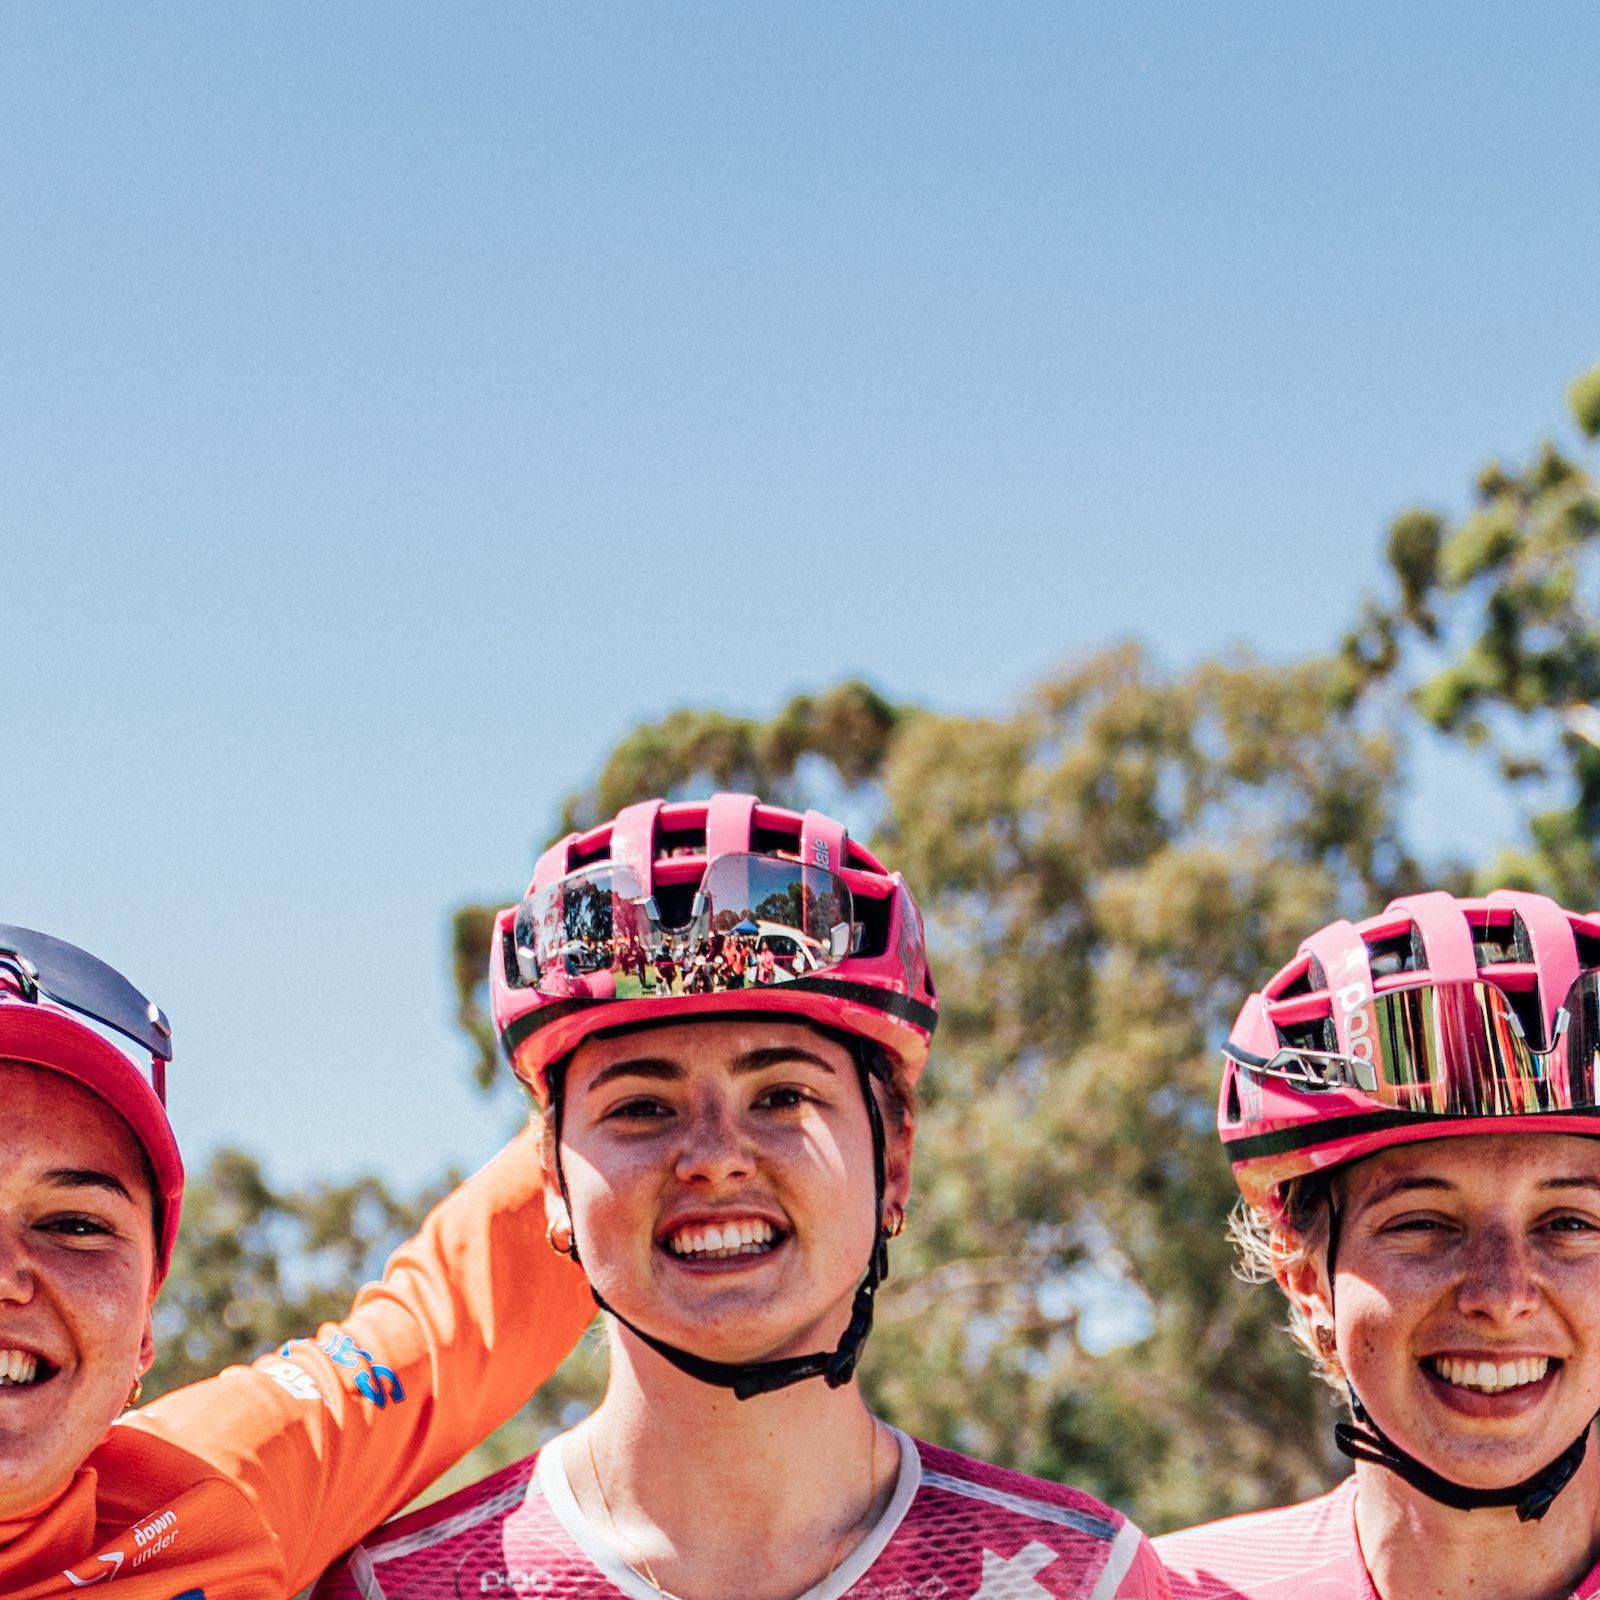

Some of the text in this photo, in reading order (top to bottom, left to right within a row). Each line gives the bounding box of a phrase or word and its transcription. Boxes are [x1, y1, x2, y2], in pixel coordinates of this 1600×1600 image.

[133, 1510, 177, 1547] down
[132, 1530, 179, 1568] under
[480, 1570, 552, 1592] poc
